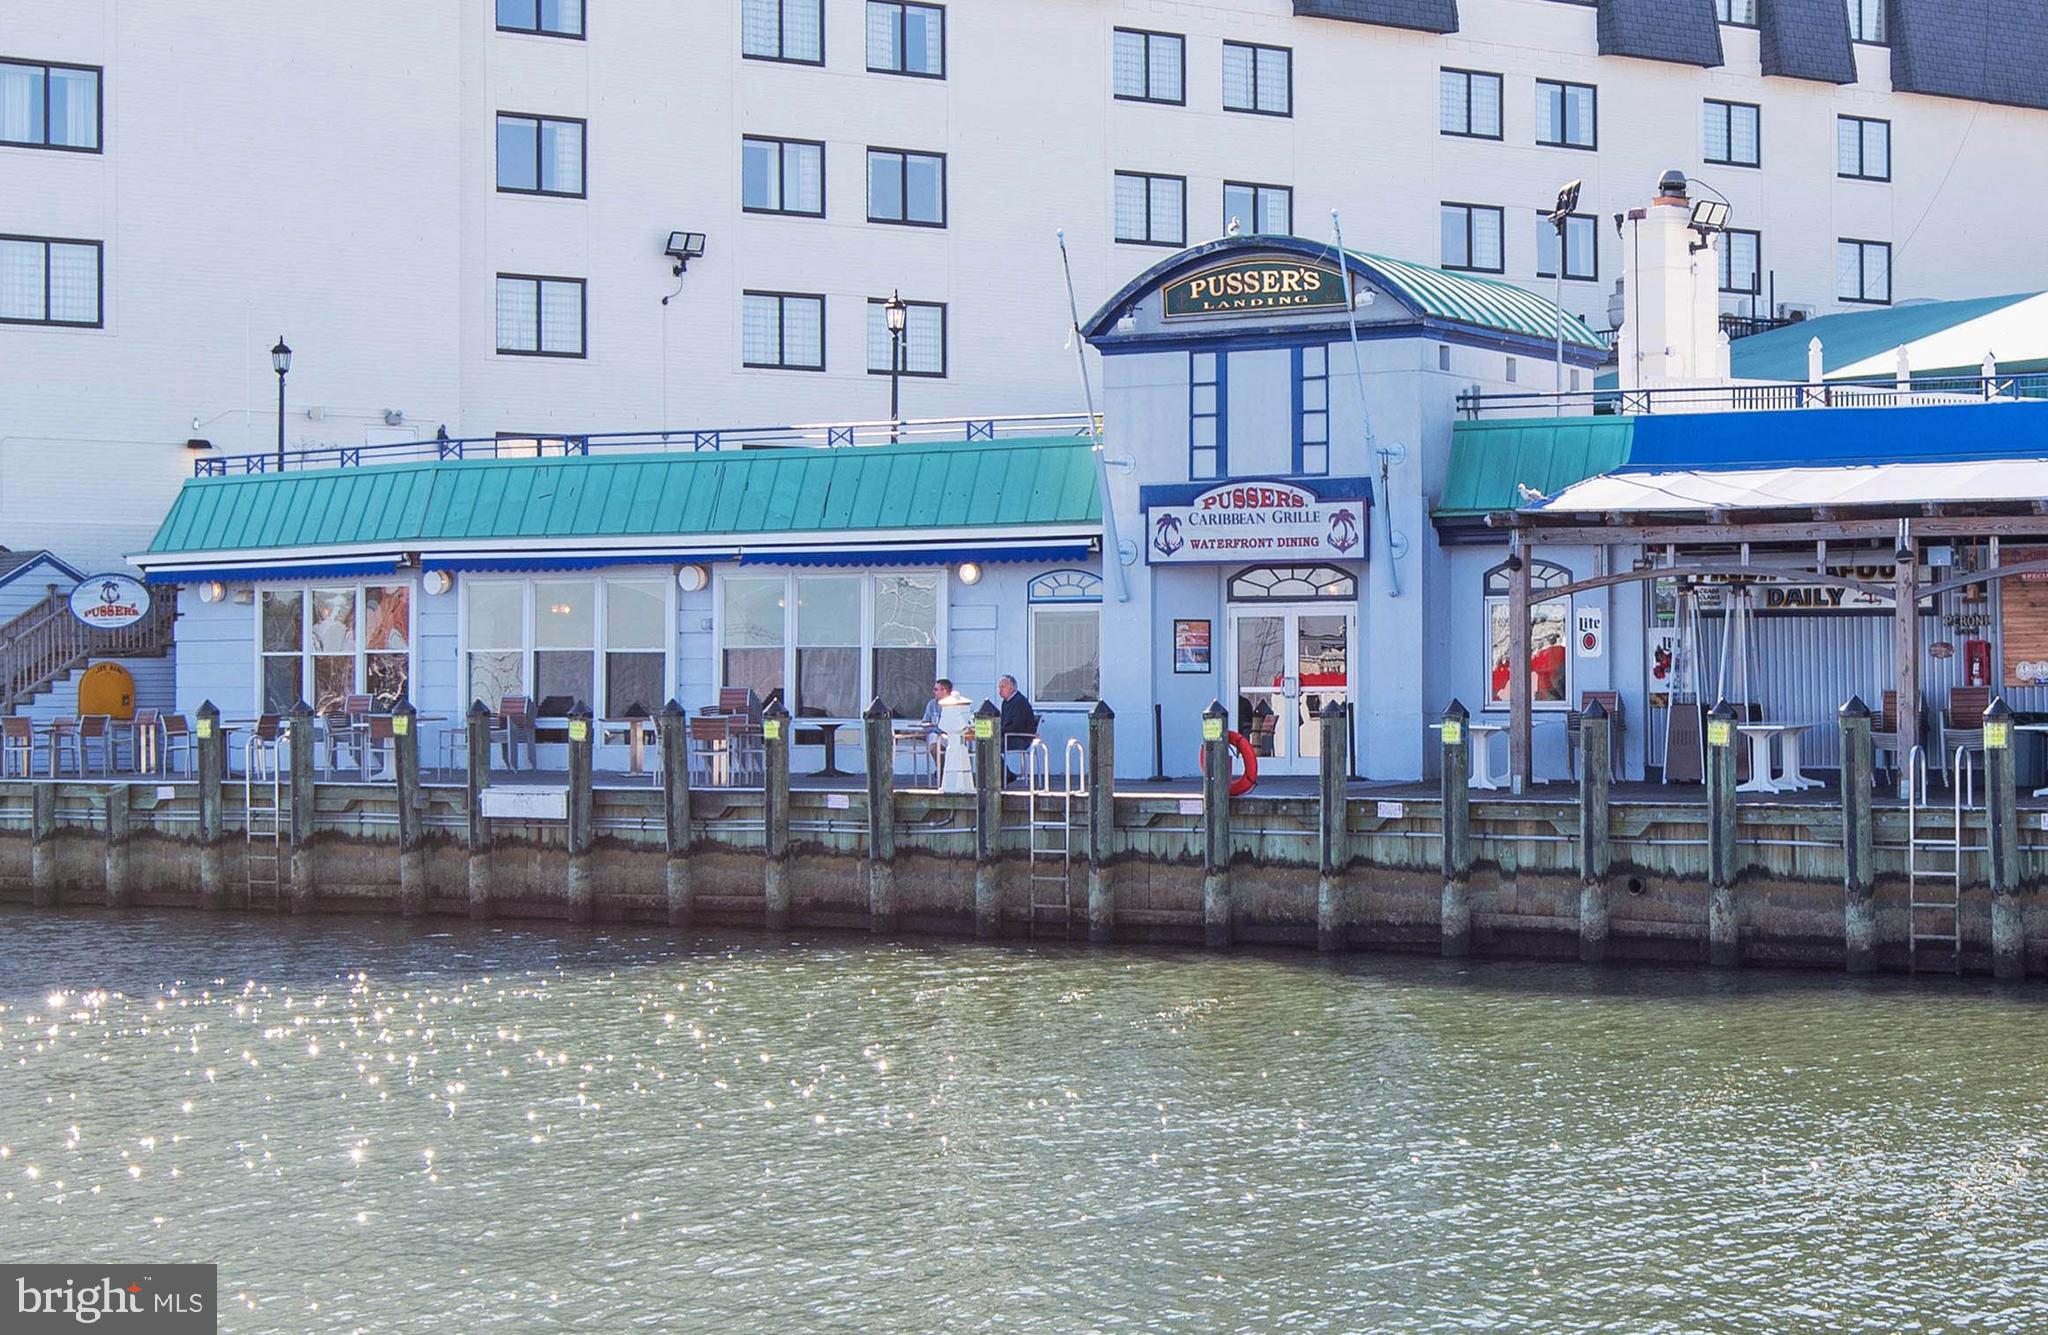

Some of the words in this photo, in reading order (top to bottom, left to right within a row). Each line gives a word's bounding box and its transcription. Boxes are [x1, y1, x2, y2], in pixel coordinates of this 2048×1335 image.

[1189, 268, 1321, 299] PUSSER'S
[1203, 295, 1309, 309] LANDING
[1202, 487, 1306, 510] PUSSER'S
[1188, 511, 1266, 526] CARIBBEAN
[1272, 510, 1321, 524] GRILLE
[1190, 538, 1274, 550] WATERFRONT
[1277, 536, 1320, 548] DINING
[1766, 587, 1846, 608] DAILY
[1579, 616, 1601, 632] Lite
